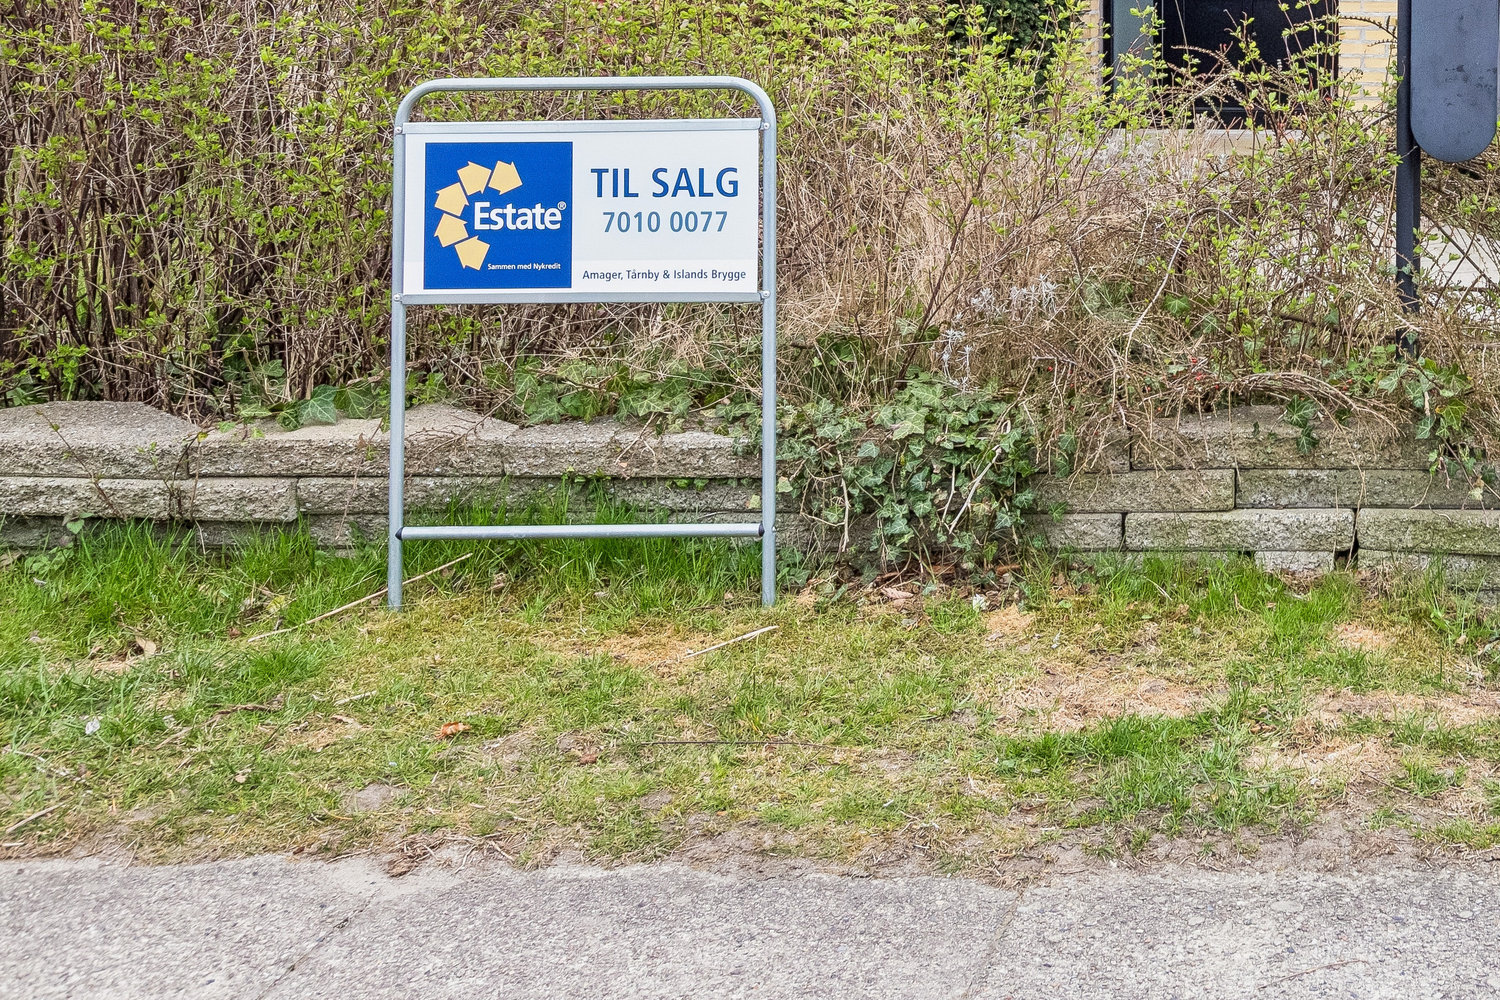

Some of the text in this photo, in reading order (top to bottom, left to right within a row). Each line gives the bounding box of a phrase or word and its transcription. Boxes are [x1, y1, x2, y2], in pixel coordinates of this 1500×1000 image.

[590, 167, 739, 198] TIL SALG
[602, 210, 728, 233] 7010 0077
[487, 262, 561, 272] Sammen med Nykredit
[582, 268, 747, 282] Amager, Tårnby & Islands Brygge
